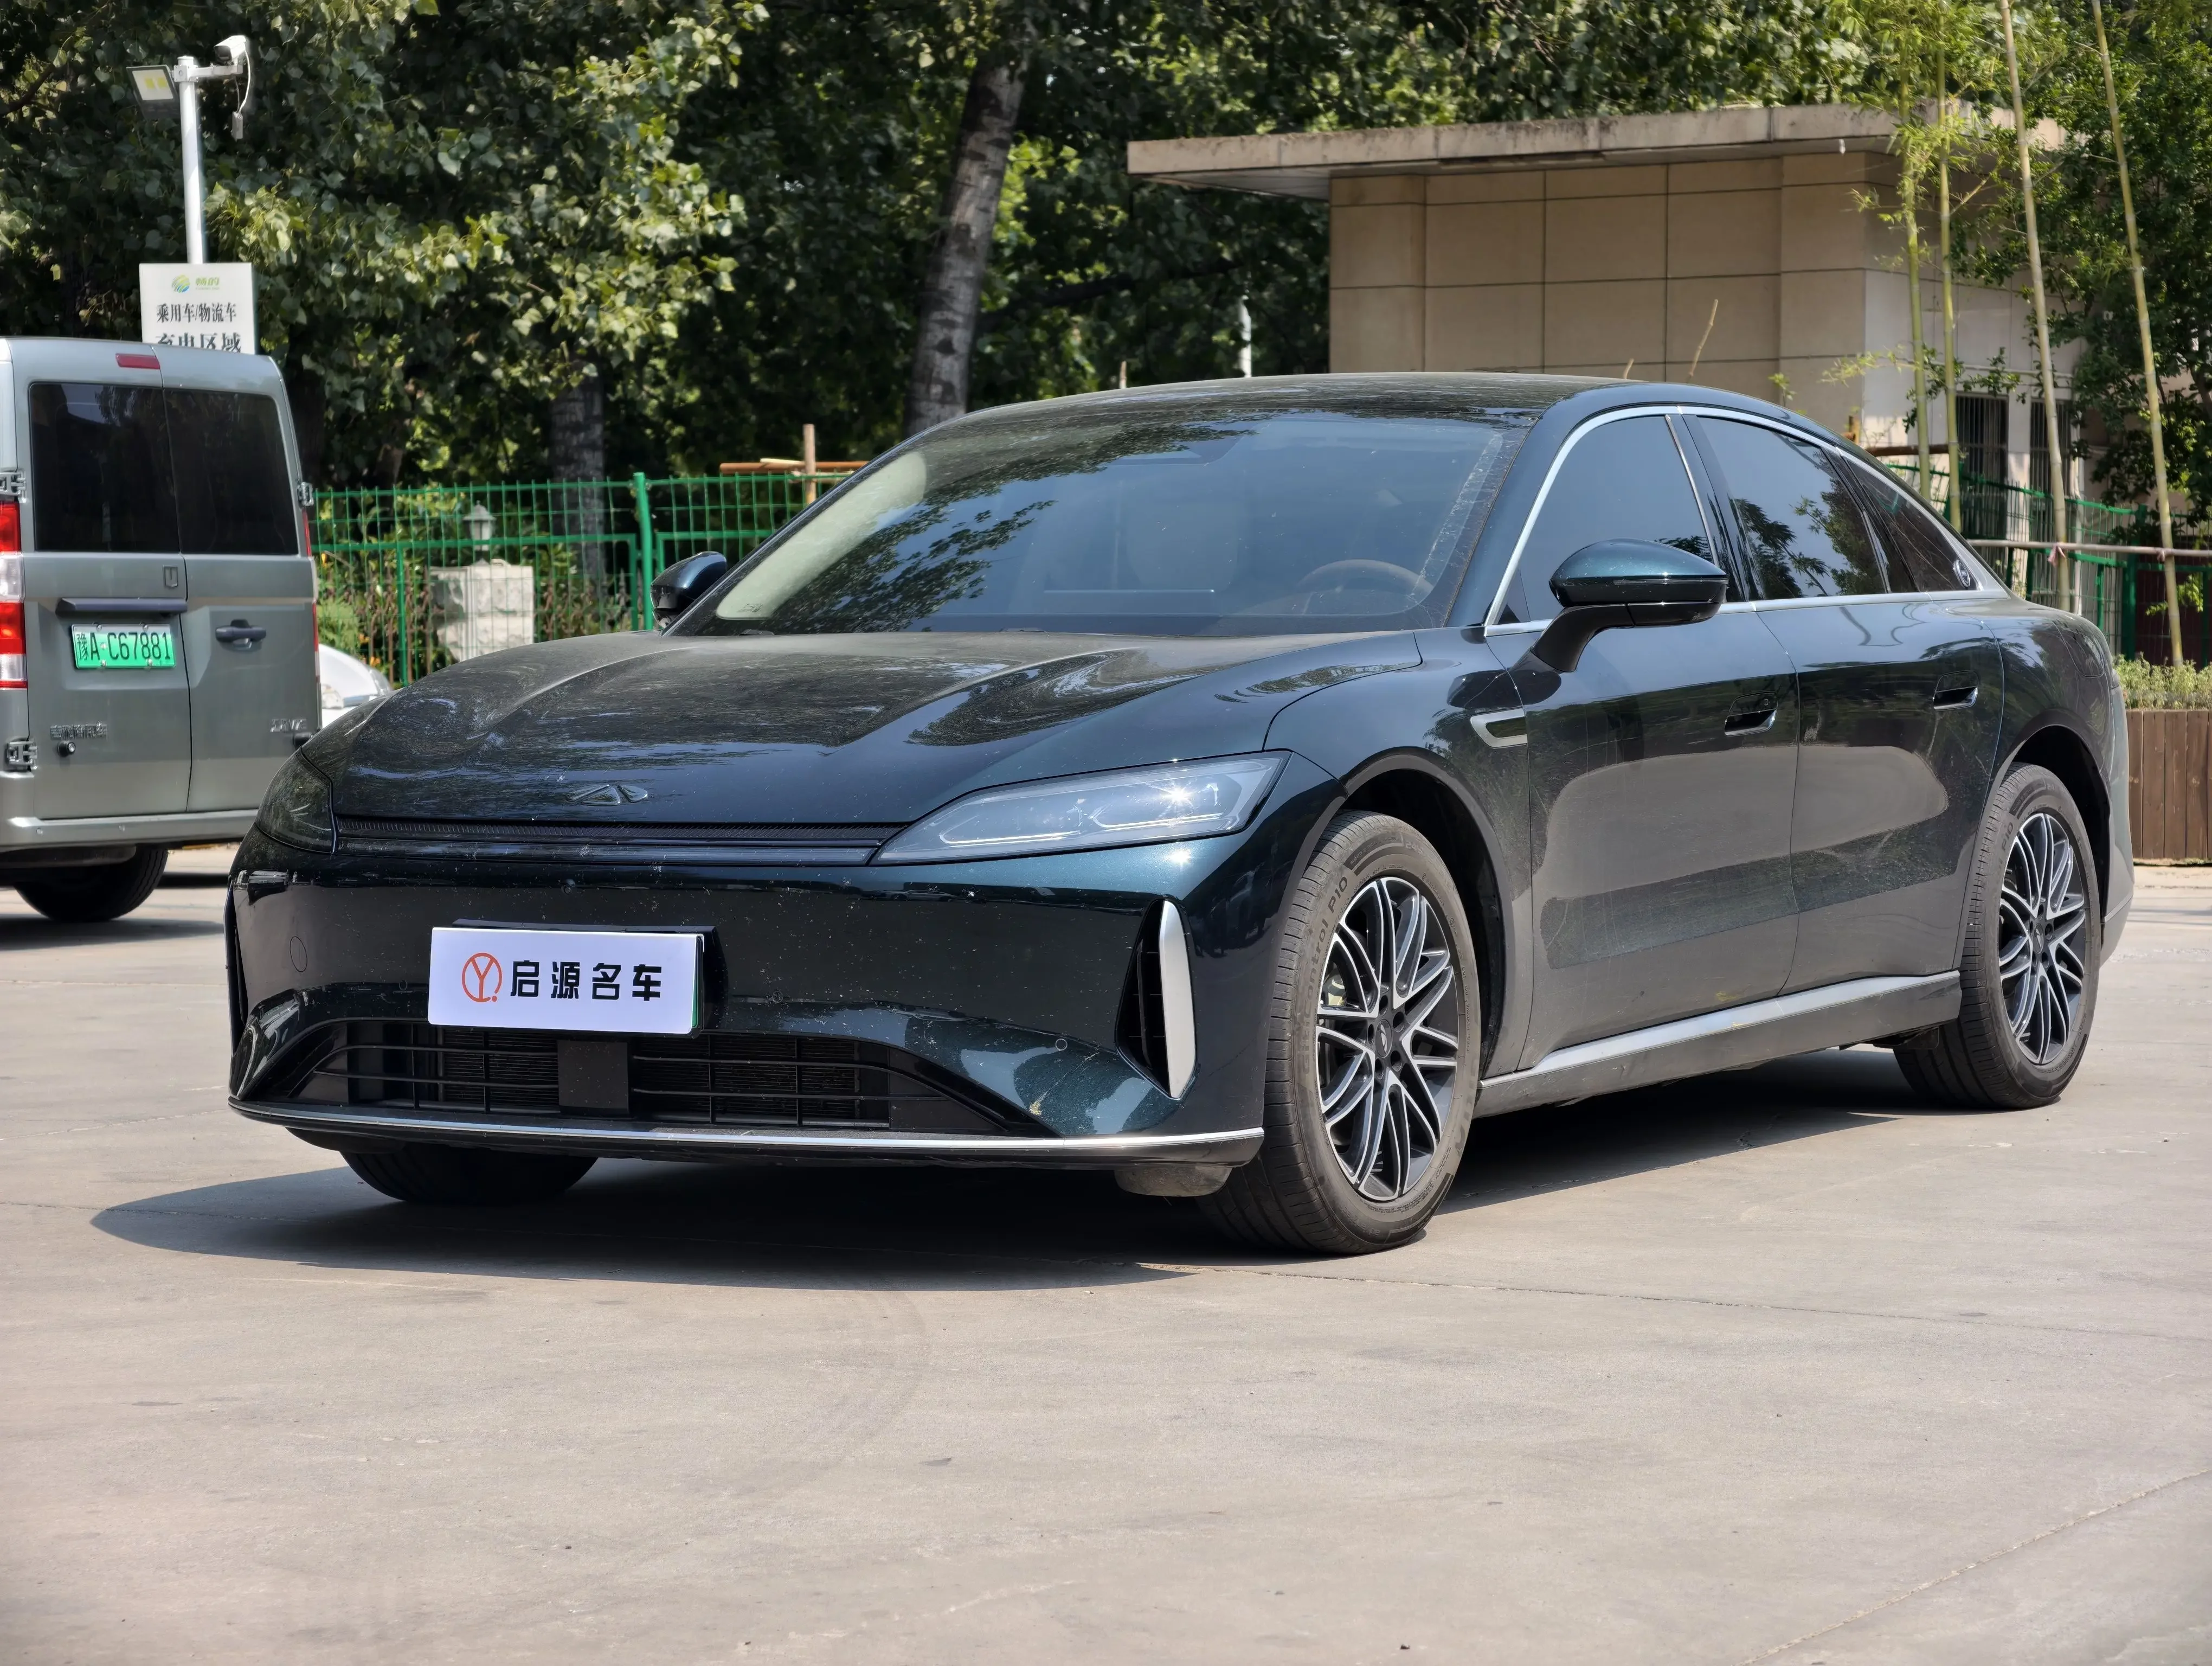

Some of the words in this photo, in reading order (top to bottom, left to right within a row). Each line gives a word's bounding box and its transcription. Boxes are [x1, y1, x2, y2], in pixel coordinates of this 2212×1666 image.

[157, 302, 236, 323] 乘用车/物流车
[1328, 876, 1348, 914] P10
[510, 960, 662, 1001] 启源名车
